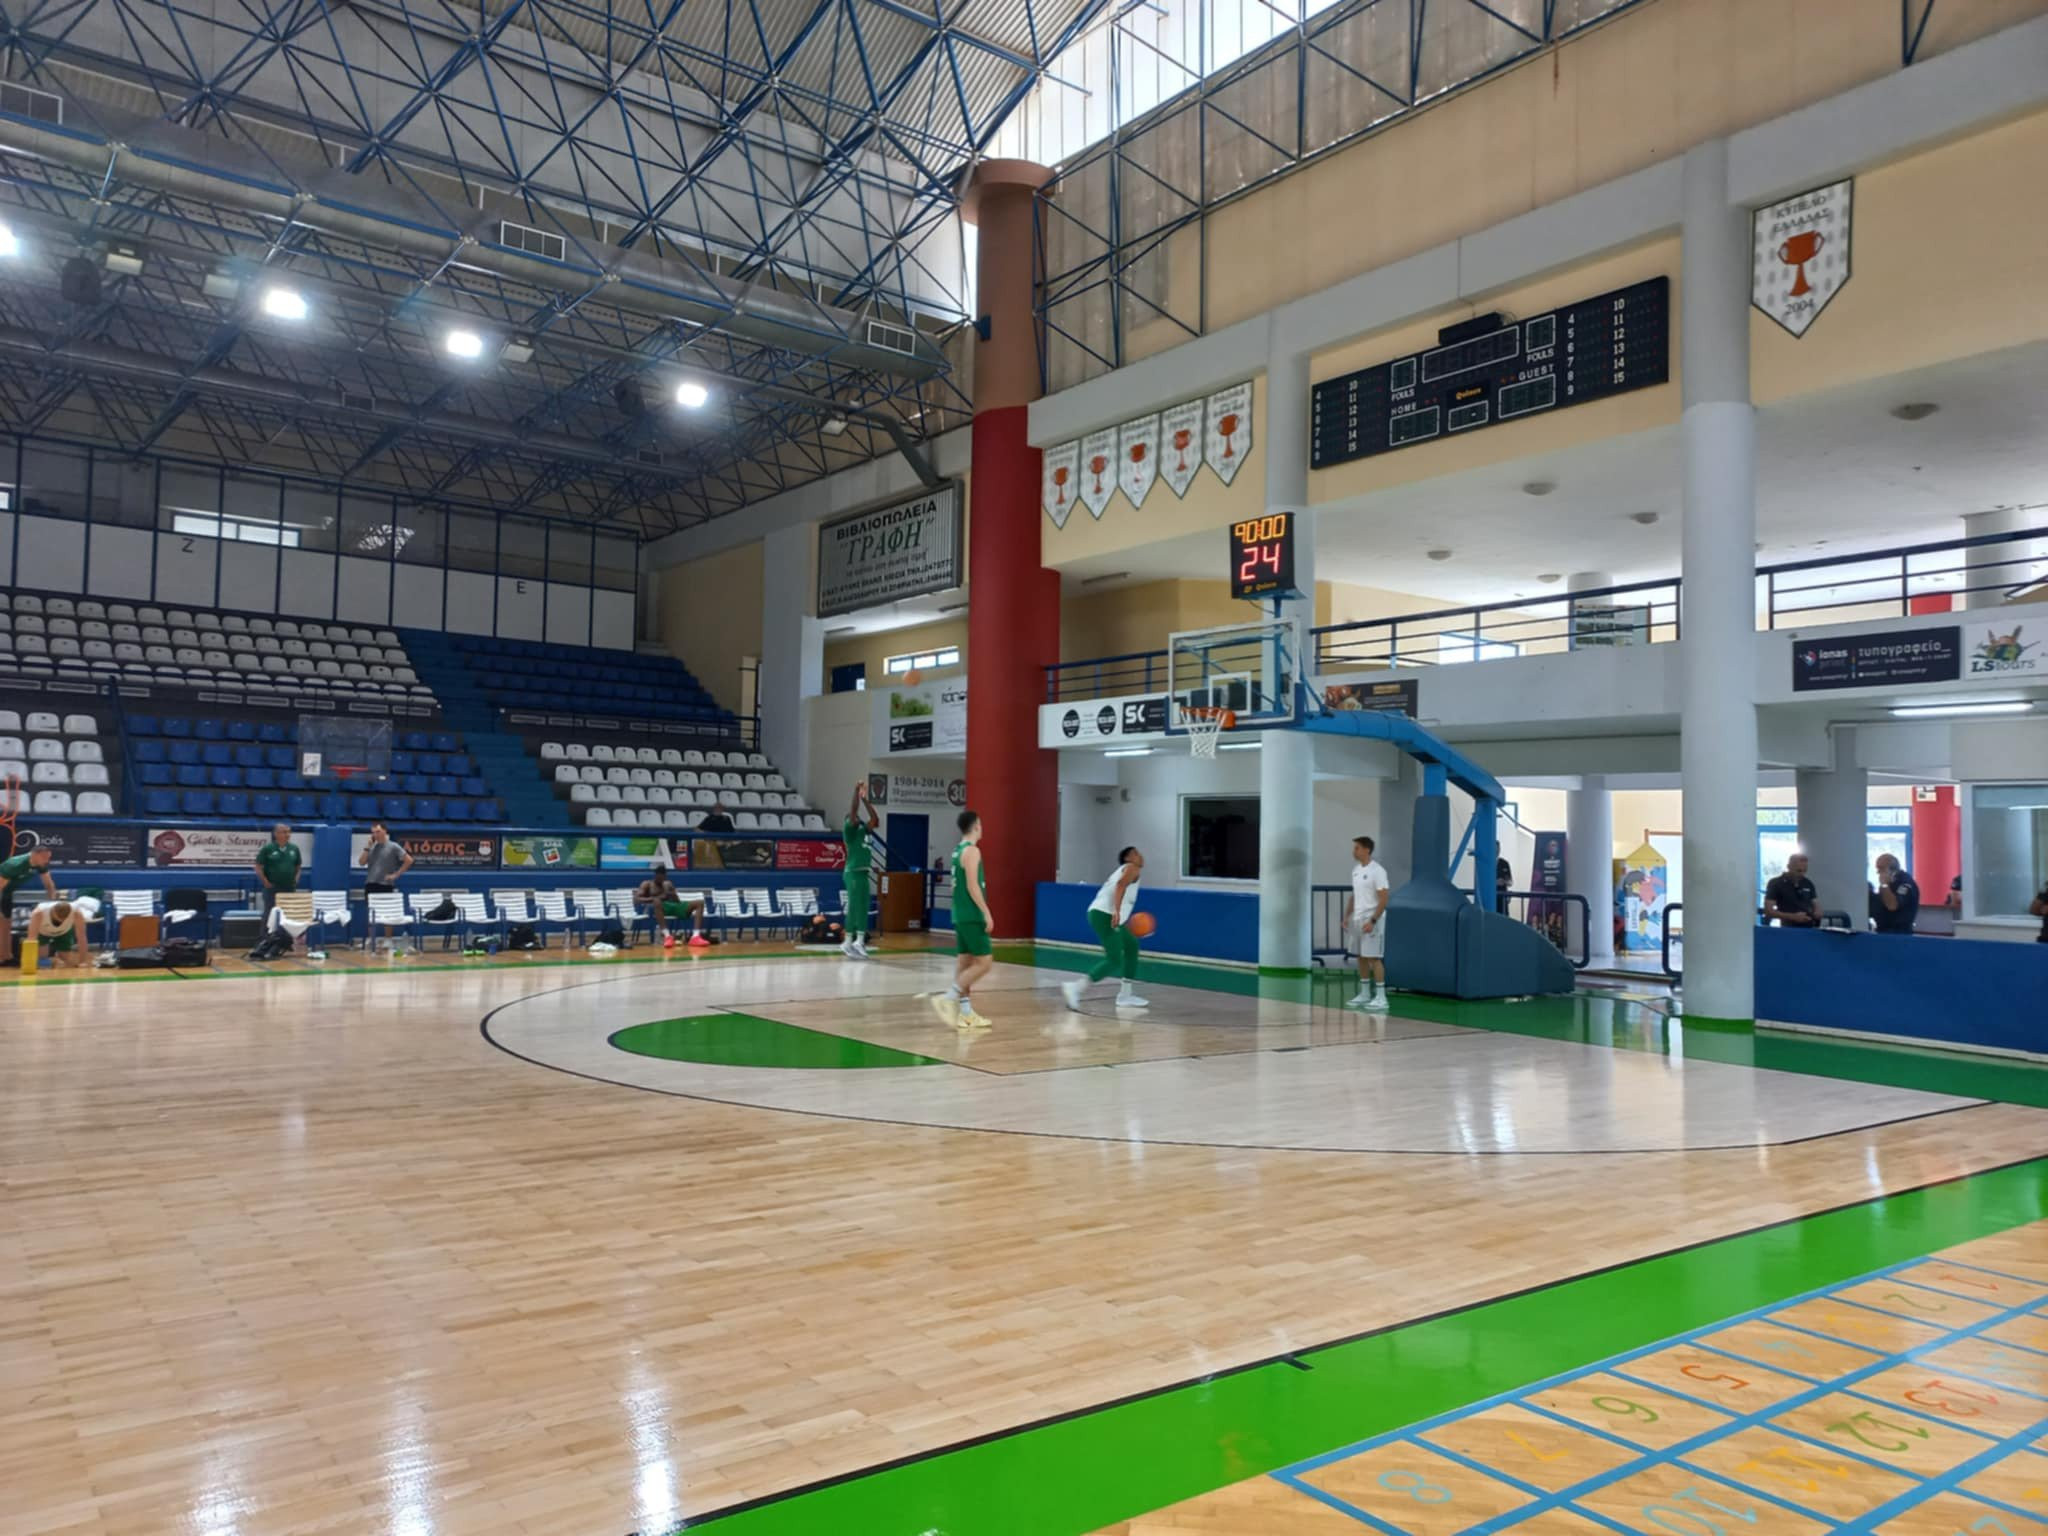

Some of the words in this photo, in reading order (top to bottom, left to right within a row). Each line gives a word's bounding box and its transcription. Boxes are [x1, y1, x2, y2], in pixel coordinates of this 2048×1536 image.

[1614, 298, 1625, 311] 10
[1568, 313, 1574, 324] 4
[1614, 314, 1625, 326] 11
[1568, 328, 1574, 339] 5
[1614, 328, 1625, 341] 12
[1568, 342, 1574, 353] 6
[1614, 342, 1625, 355] 13
[1526, 348, 1554, 364] FOULS
[1568, 356, 1574, 368] 7
[1614, 357, 1625, 370] 14
[1518, 364, 1554, 381] GUEST
[1568, 370, 1574, 381] 8
[1614, 371, 1625, 385] 15
[1348, 380, 1358, 391] 10
[1568, 384, 1574, 395] 9
[1348, 393, 1358, 403] 11
[1391, 388, 1415, 402] FOULS
[1348, 405, 1358, 416] 12
[1391, 402, 1417, 416] HOME
[1348, 417, 1358, 428] 13
[1348, 429, 1358, 440] 14
[1348, 441, 1358, 452] 15
[837, 500, 937, 540] ΒΙΒΛΙΟΠΩΛΕΙΑ
[1241, 543, 1280, 580] 24
[894, 776, 945, 788] 1984-2014
[1680, 1364, 1750, 1390] 5
[1825, 1411, 1931, 1452] 12
[1377, 1469, 1454, 1505] 8
